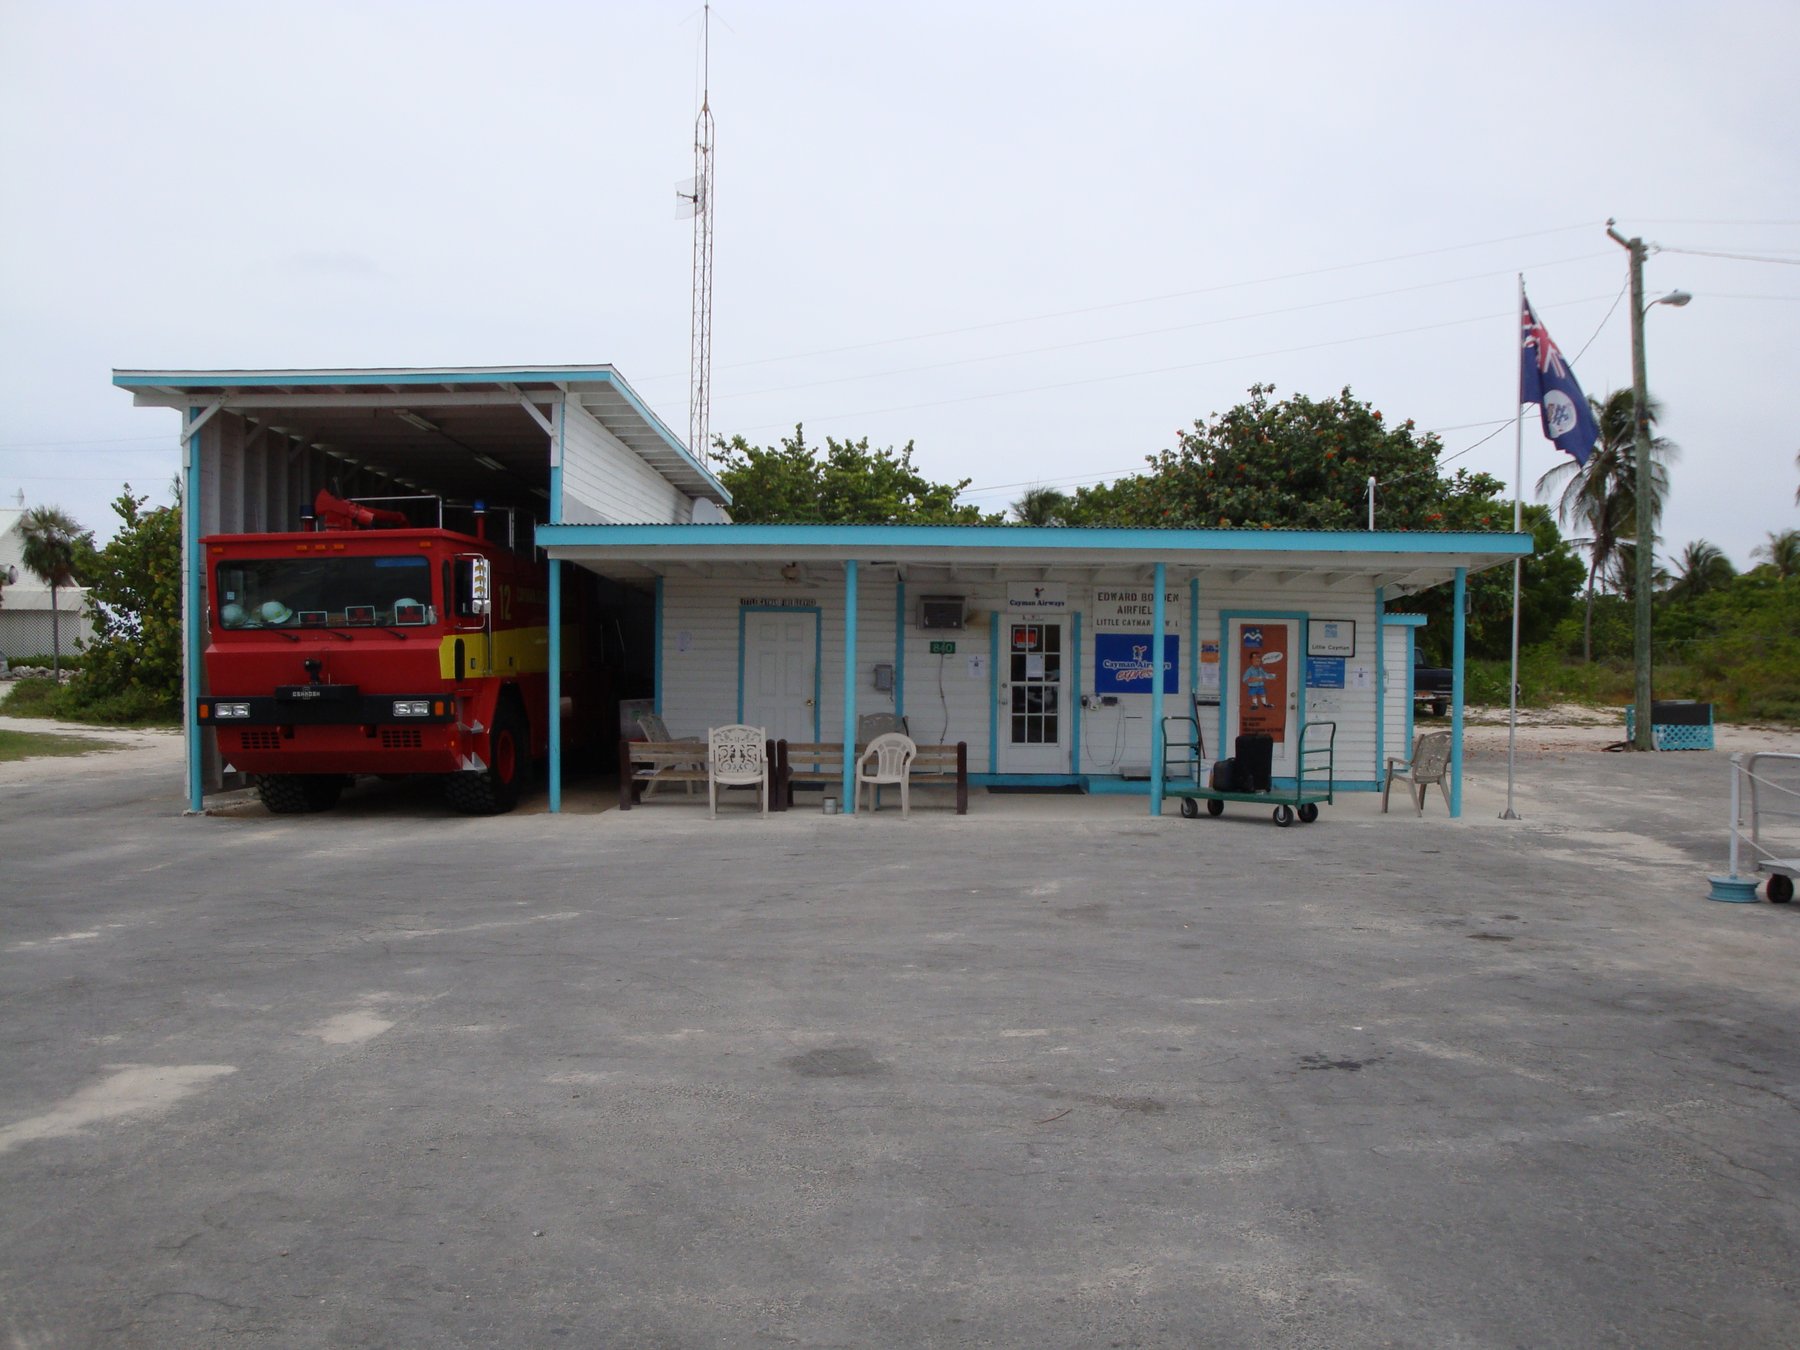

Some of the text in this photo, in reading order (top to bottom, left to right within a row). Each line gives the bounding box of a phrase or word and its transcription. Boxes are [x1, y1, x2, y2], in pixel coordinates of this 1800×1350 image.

[498, 584, 511, 620] 12
[1097, 591, 1179, 603] EDWARD BOEN
[1009, 599, 1065, 607] Cayman Airways
[1117, 605, 1153, 615] AIRFIEL
[1096, 618, 1119, 626] LITTLE
[1122, 619, 1151, 627] CAYMAN
[933, 642, 953, 653] 840
[1103, 660, 1172, 671] Cayman Airys
[1116, 669, 1154, 682] expres
